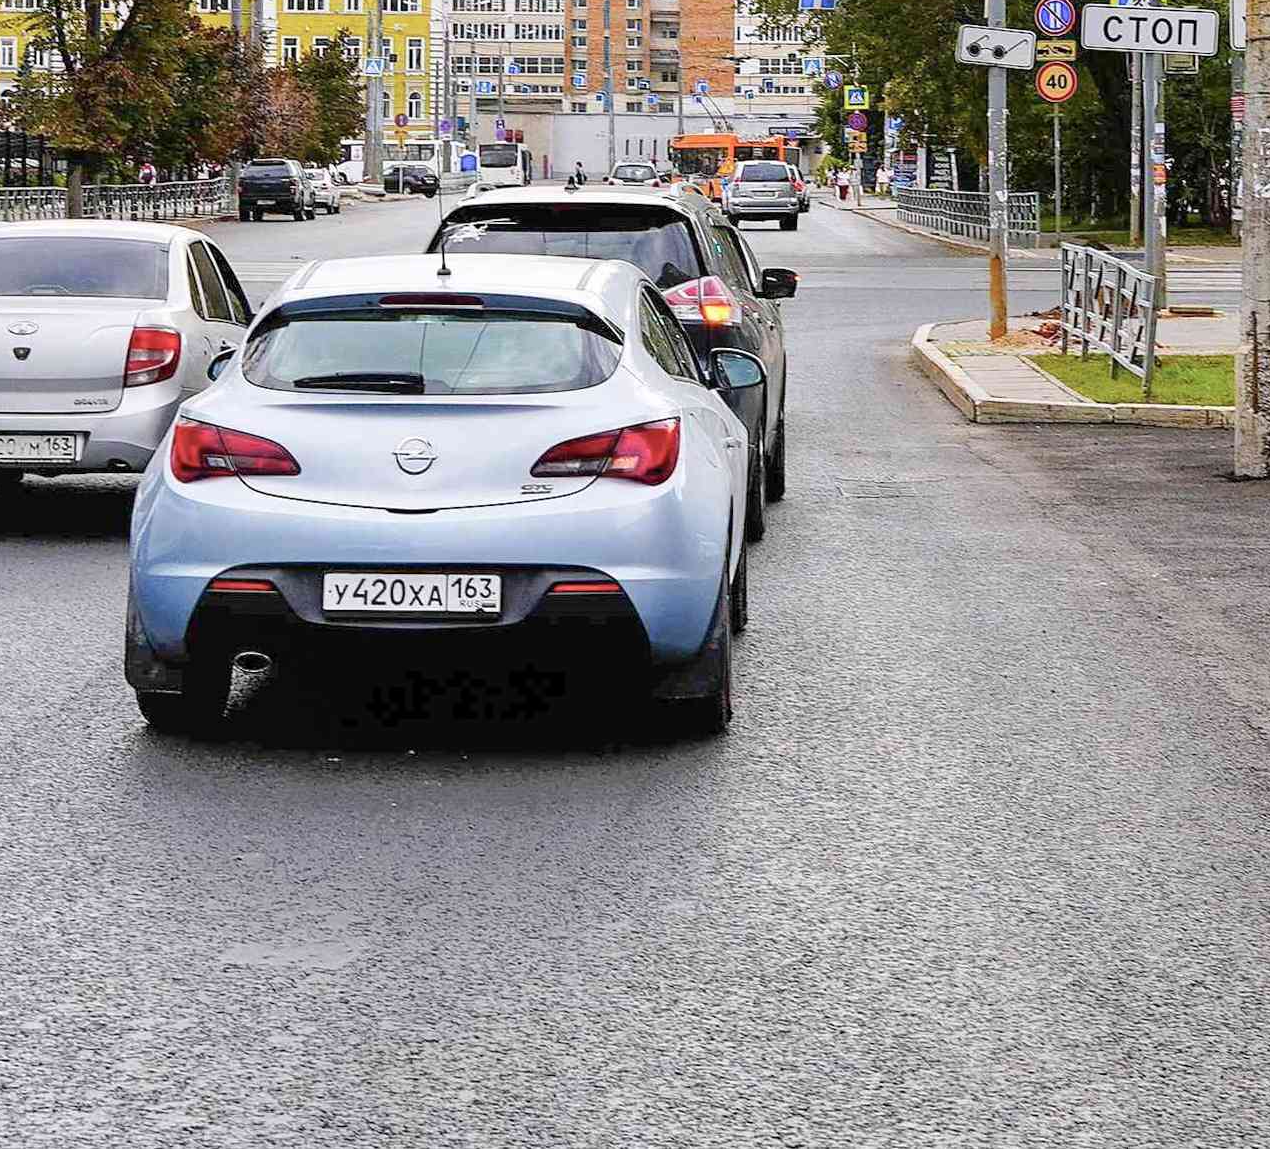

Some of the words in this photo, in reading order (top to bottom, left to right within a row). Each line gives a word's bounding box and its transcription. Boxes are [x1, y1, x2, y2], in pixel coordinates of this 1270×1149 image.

[1103, 16, 1198, 45] СТОП
[1046, 74, 1068, 89] 40
[45, 437, 70, 451] 163
[451, 577, 492, 599] 163
[460, 600, 480, 609] RUS
